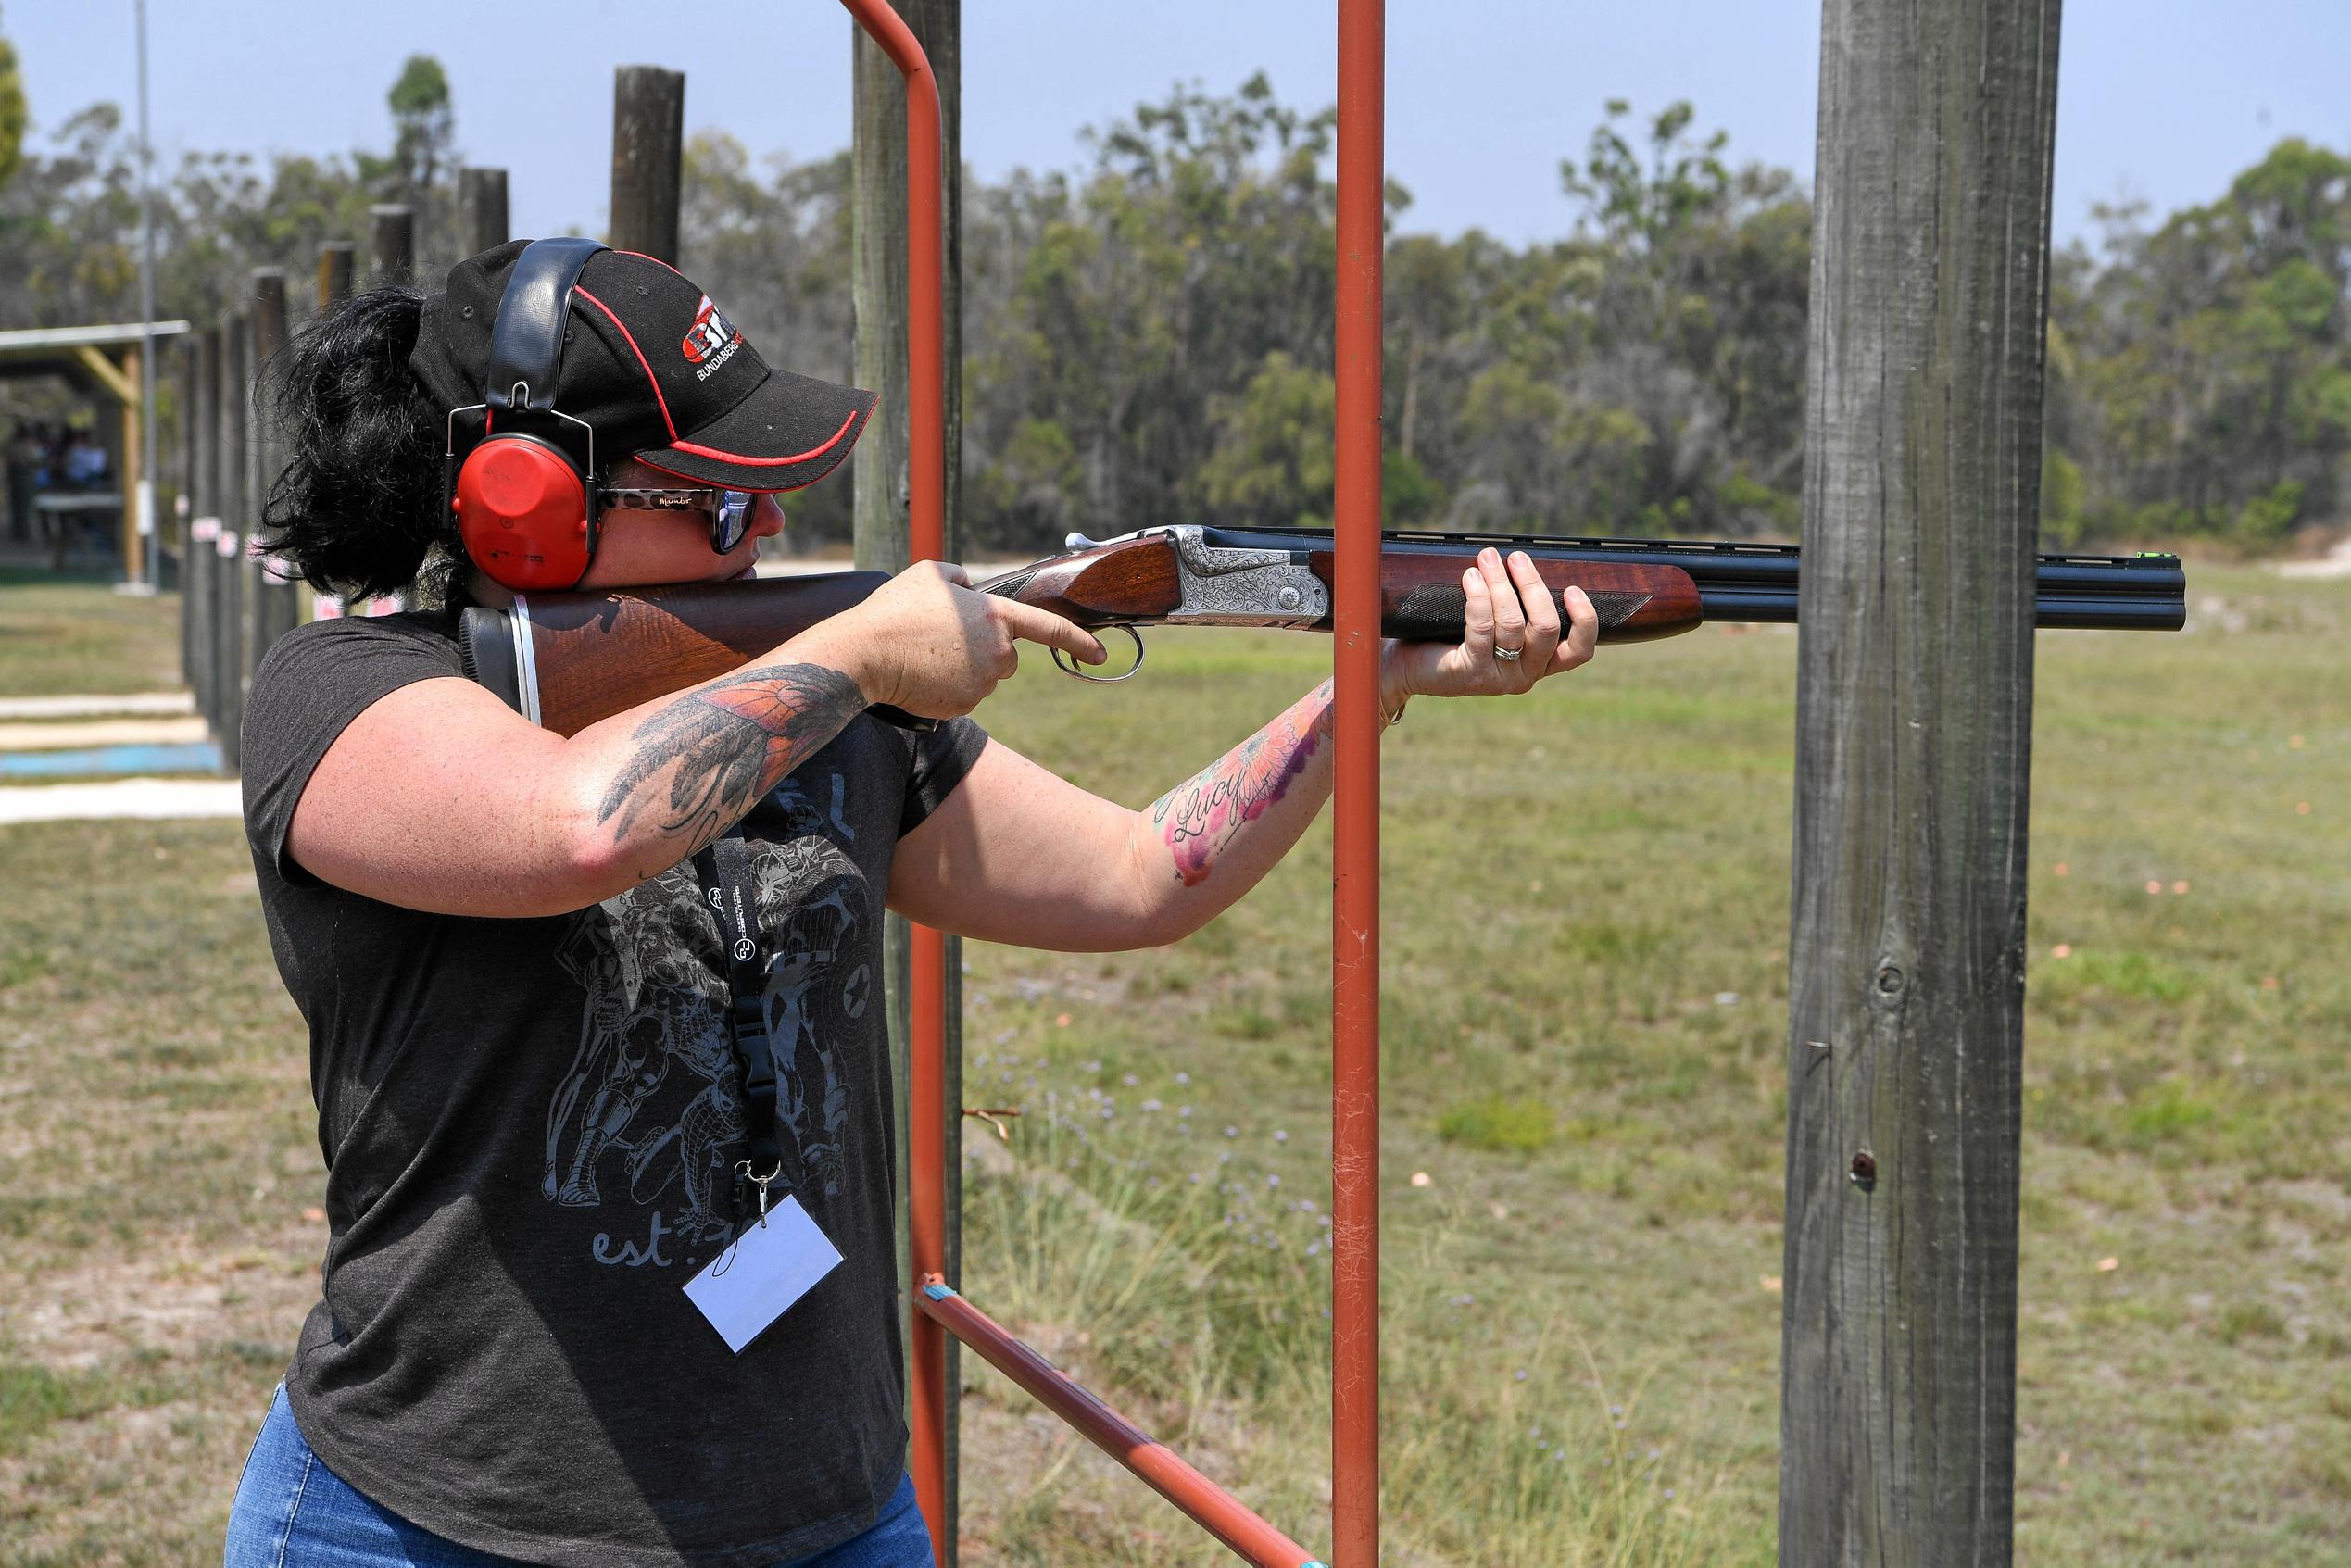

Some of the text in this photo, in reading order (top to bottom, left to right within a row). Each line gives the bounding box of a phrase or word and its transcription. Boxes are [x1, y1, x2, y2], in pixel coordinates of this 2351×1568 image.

[696, 340, 739, 382] BUNDABERG
[1174, 770, 1247, 843] Lucy
[735, 885, 747, 938] COMPUTERS
